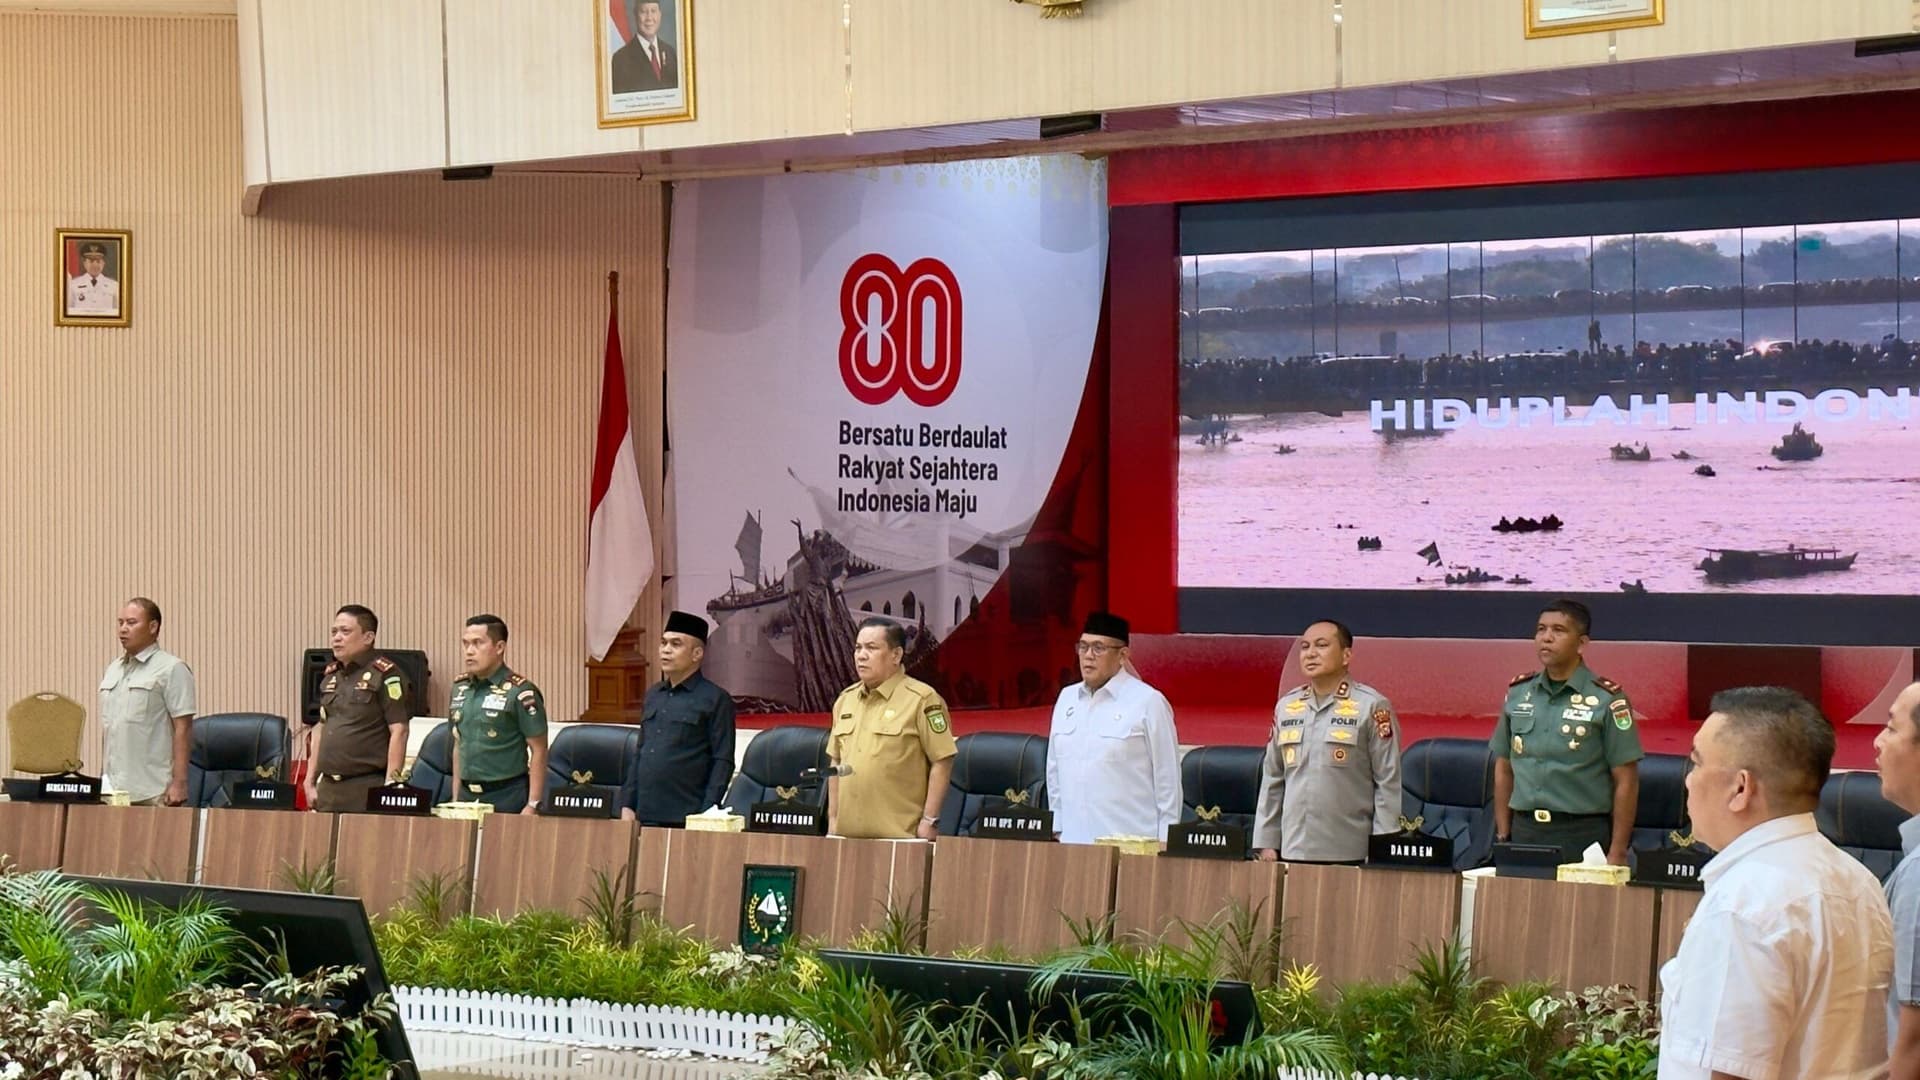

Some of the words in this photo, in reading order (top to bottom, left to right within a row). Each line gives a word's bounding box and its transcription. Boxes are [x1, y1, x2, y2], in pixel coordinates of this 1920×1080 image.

[838, 252, 964, 408] 80
[1370, 393, 1669, 431] HIDUPLAH
[839, 420, 914, 447] Bersatu
[919, 423, 1008, 449] Berdaulat
[838, 453, 905, 485] Rakyat
[909, 455, 998, 486] Sejahtera
[837, 487, 930, 512] Indonesia
[935, 488, 977, 519] Maju
[1330, 717, 1357, 726] POLRI
[554, 796, 580, 807] KETUA
[755, 812, 770, 823] PLT
[1187, 833, 1227, 846] KAPOLDA
[1390, 844, 1433, 857] DANREM
[1667, 863, 1695, 877] DPRD
